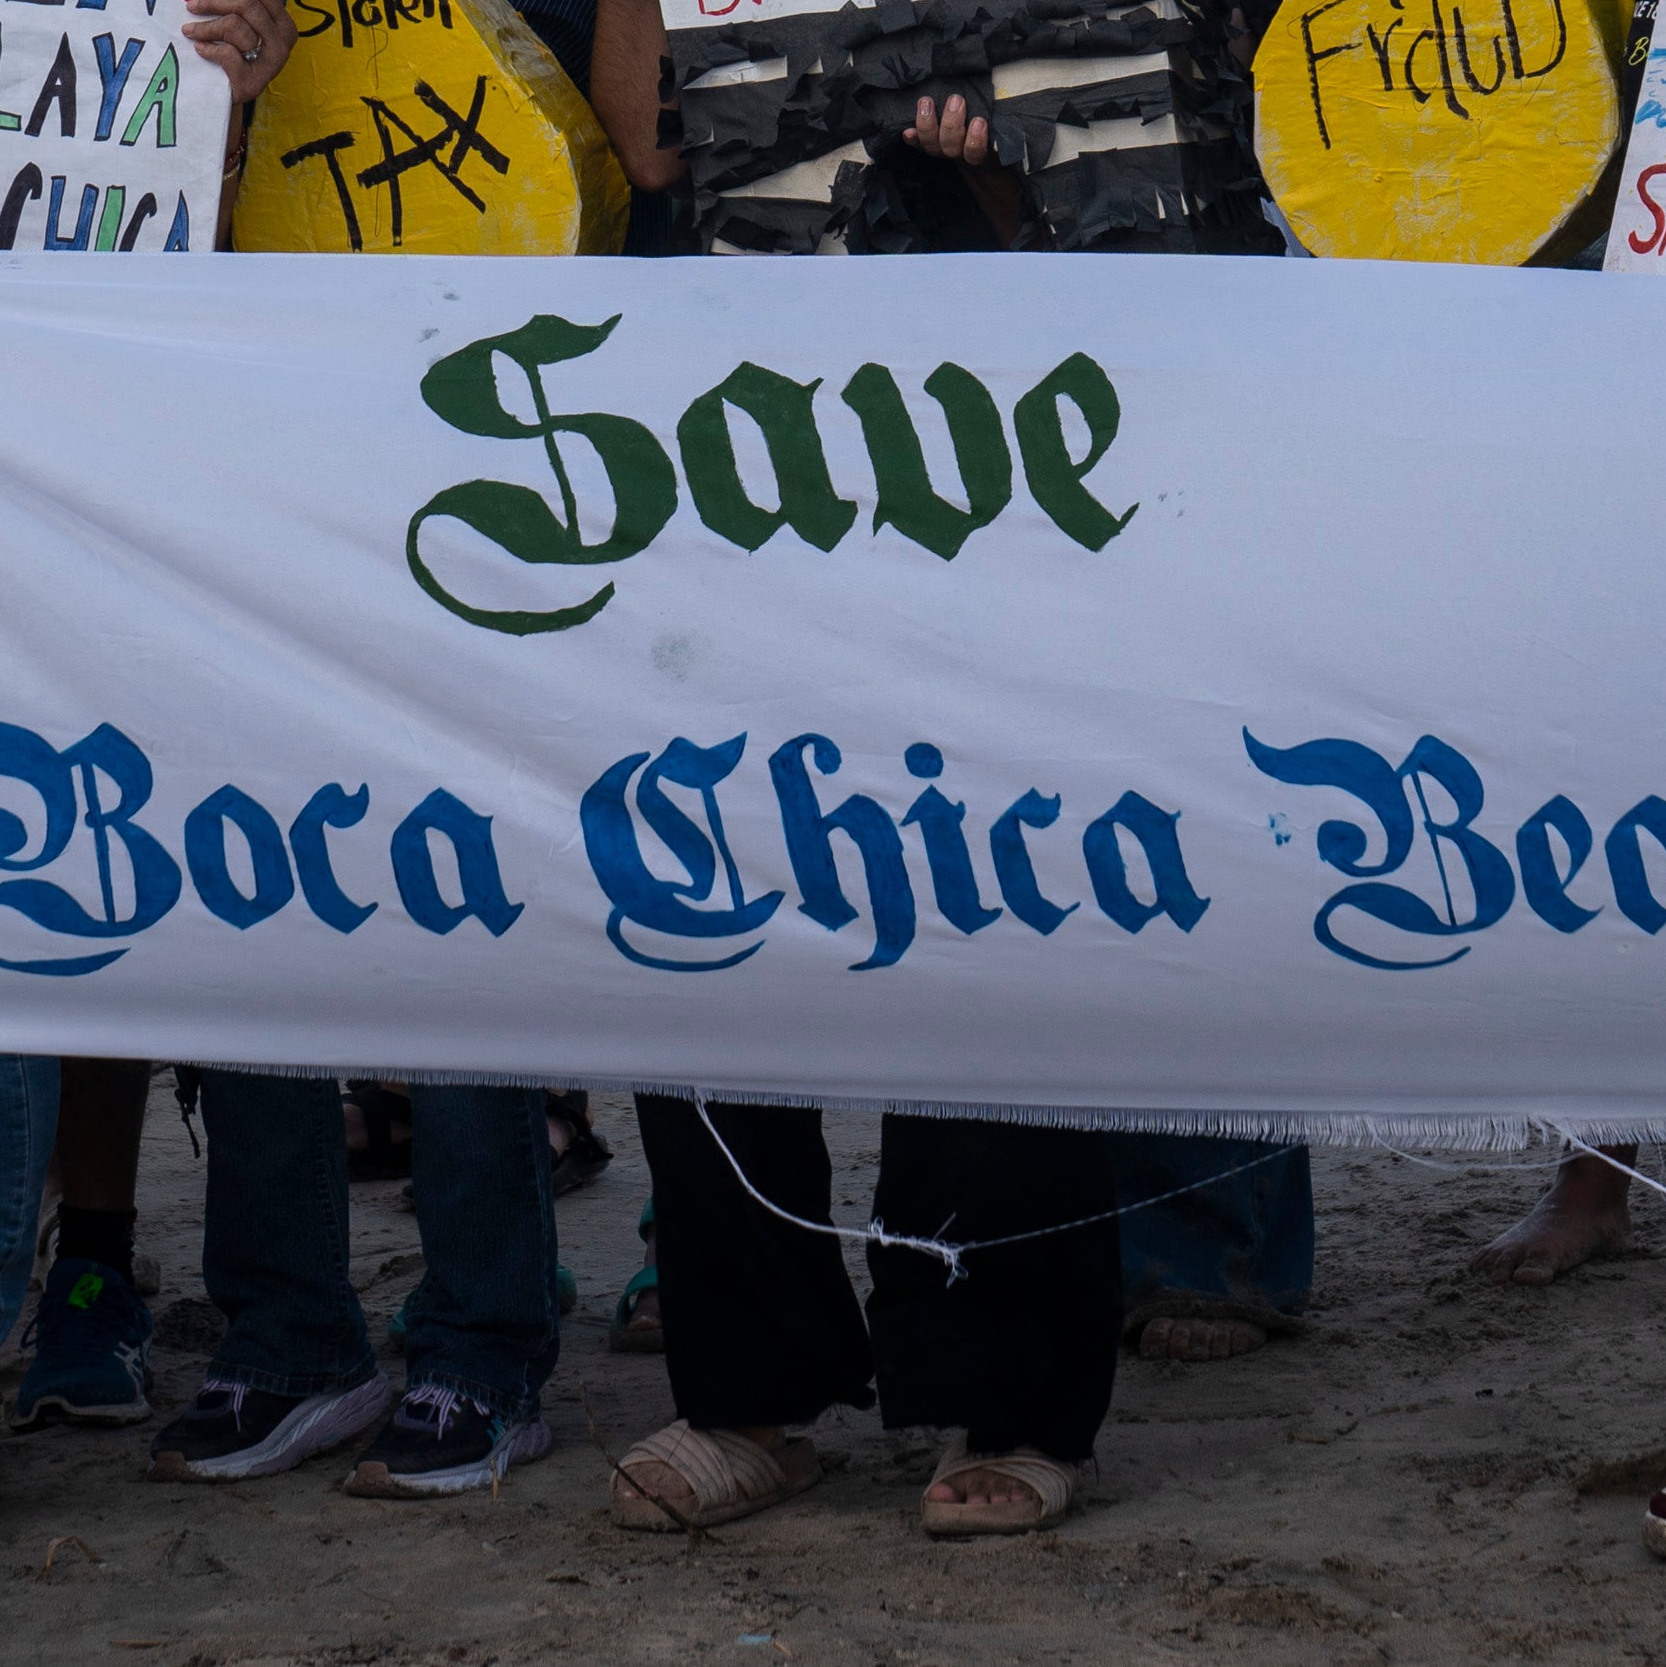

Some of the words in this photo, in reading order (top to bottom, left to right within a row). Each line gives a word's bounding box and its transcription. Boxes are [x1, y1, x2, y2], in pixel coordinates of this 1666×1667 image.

[281, 74, 511, 253] TAX
[404, 310, 1139, 640] Save
[580, 728, 1212, 976] Chica
